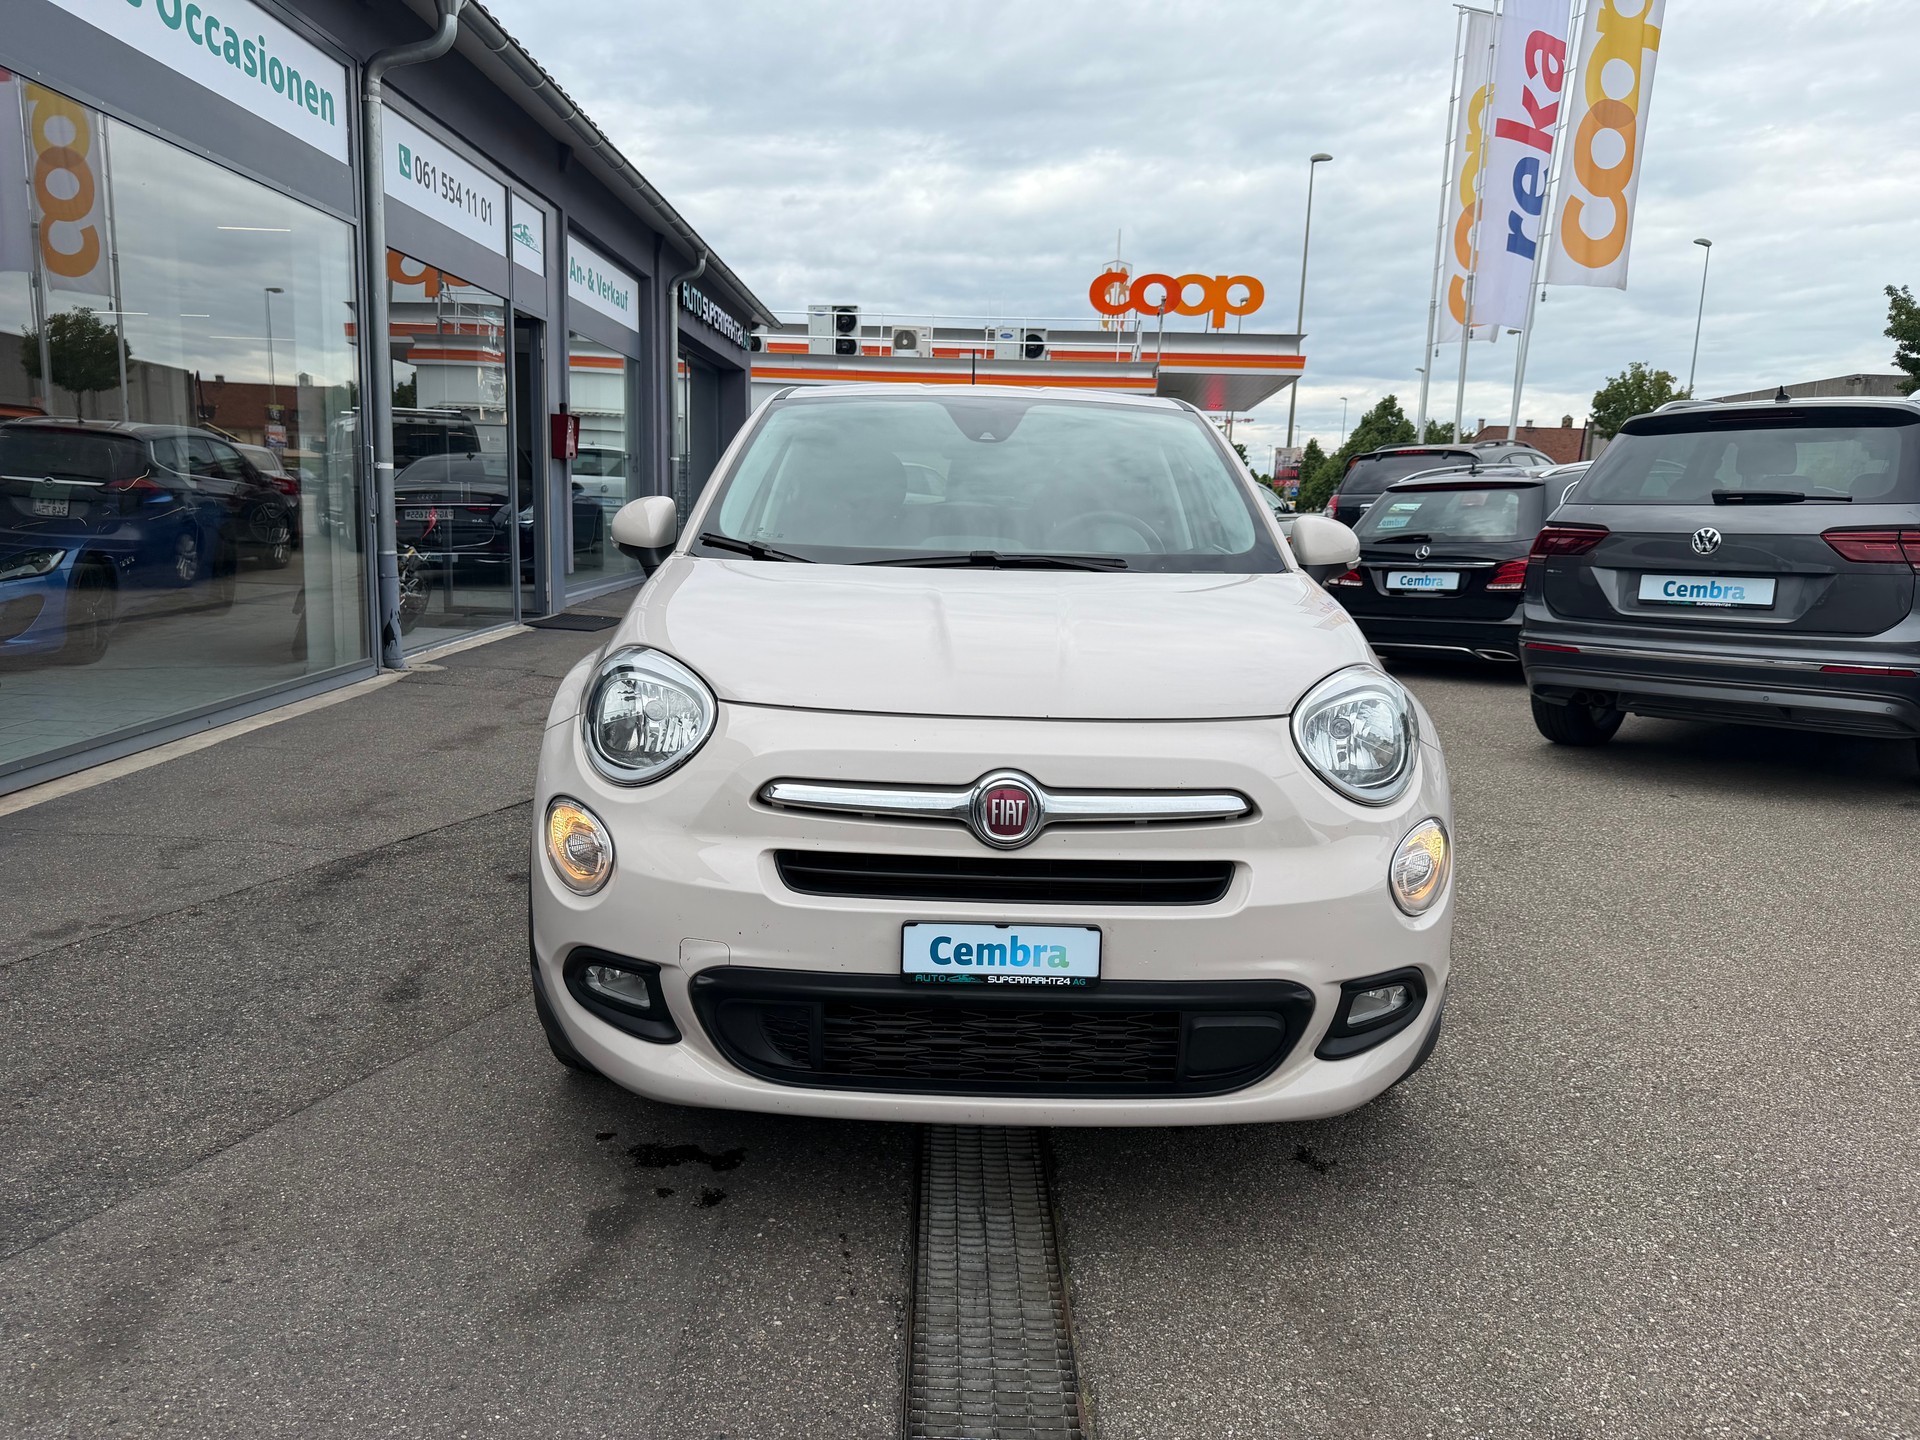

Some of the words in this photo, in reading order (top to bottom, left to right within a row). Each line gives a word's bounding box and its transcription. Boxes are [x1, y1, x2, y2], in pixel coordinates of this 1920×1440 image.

[1495, 30, 1566, 261] reka
[414, 155, 437, 194] 061
[441, 171, 462, 208] 554
[465, 188, 477, 217] 11
[481, 197, 492, 226] 01
[569, 256, 585, 285] An-
[588, 267, 594, 293] &
[596, 272, 628, 312] Verkauf
[683, 281, 702, 317] AUTO
[1400, 575, 1443, 587] Cembra
[1663, 580, 1746, 600] Cembra
[991, 799, 1026, 826] FIAT
[929, 935, 1070, 969] Cembra
[915, 974, 946, 982] AUTO
[987, 975, 1071, 986] SUPERMARKT24
[1072, 978, 1086, 986] AG
